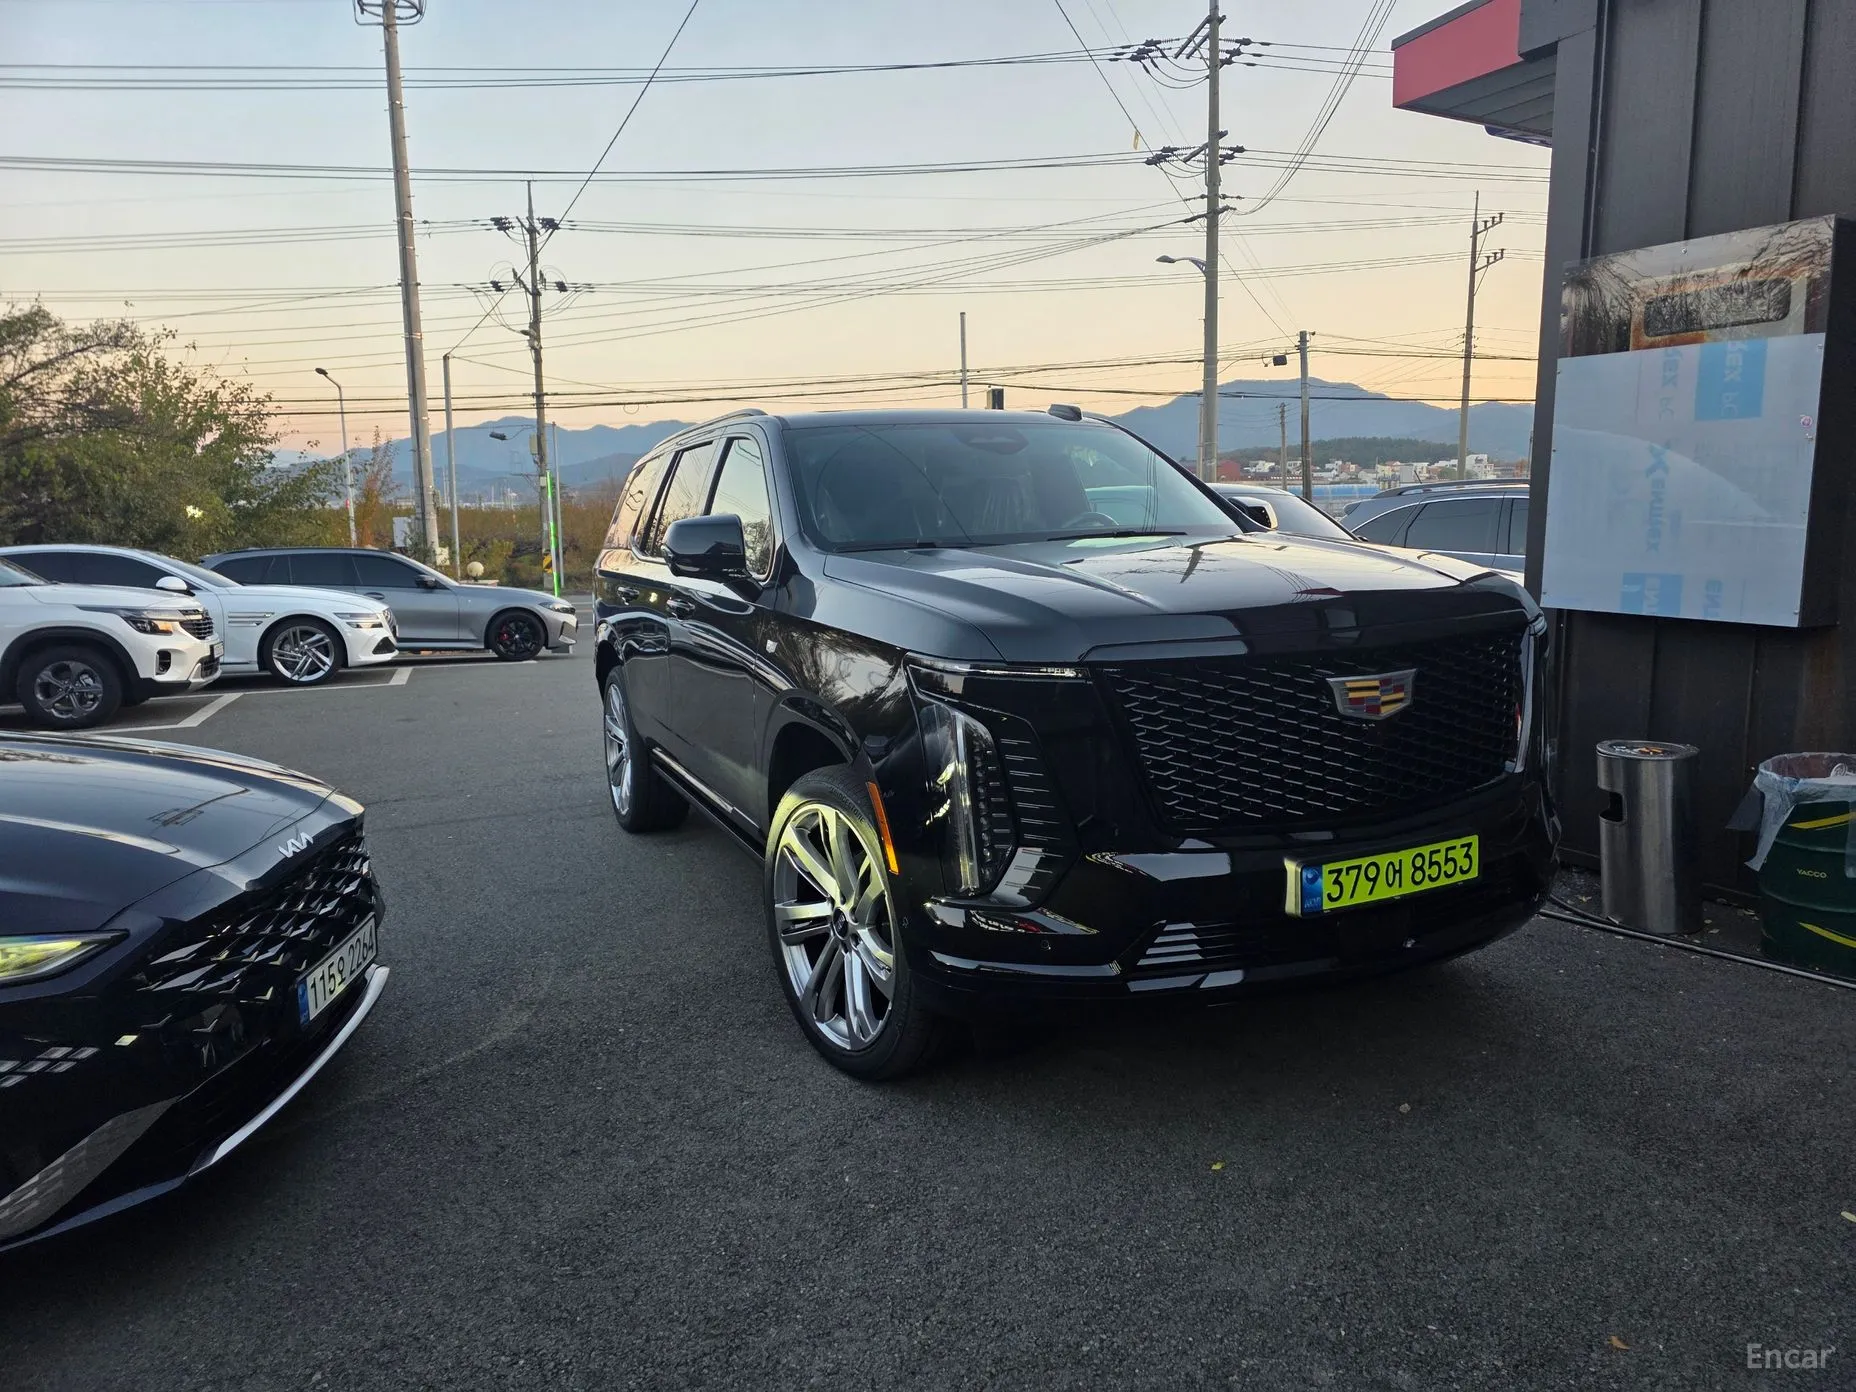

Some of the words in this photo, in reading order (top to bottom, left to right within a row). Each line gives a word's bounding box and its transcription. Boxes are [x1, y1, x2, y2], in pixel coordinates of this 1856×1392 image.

[278, 831, 314, 858] KIA
[1326, 858, 1403, 903] 379어
[1411, 841, 1473, 886] 8553
[1797, 868, 1827, 879] YACCO
[348, 928, 375, 980] 2264
